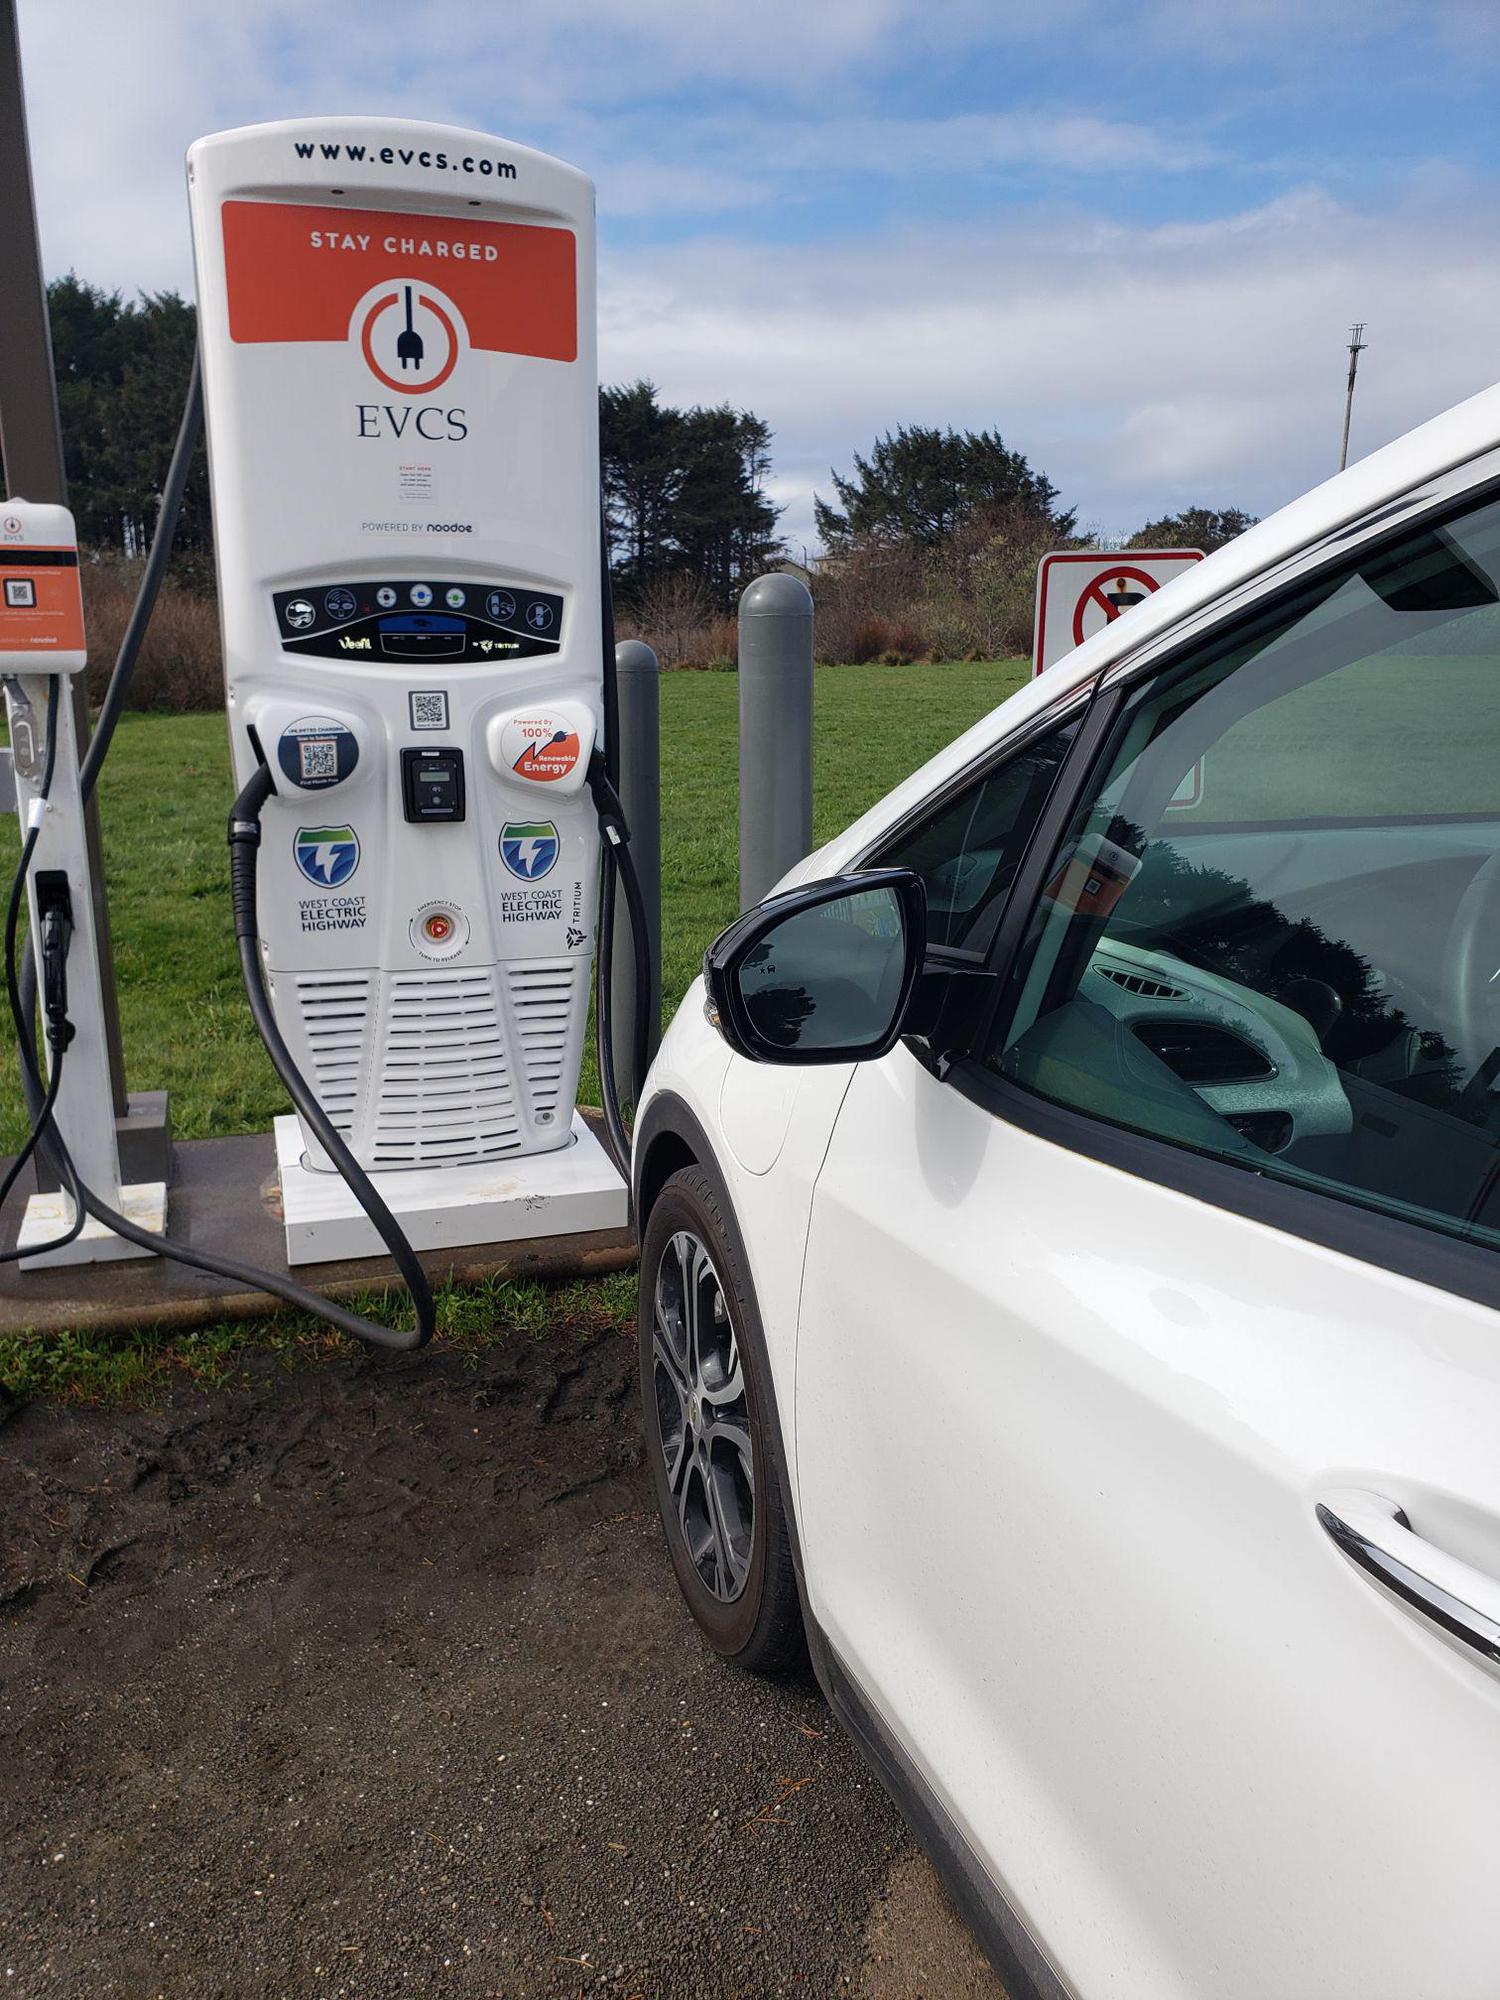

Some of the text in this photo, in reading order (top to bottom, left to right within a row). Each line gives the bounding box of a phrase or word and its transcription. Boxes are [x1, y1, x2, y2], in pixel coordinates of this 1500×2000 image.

[294, 141, 517, 180] www.evcs.com
[310, 231, 499, 262] STAY CHARGED
[355, 404, 468, 442] EVCS
[361, 522, 473, 534] POWERED BY noodoe
[521, 727, 553, 738] 100%
[523, 761, 568, 775] Energy
[501, 889, 563, 901] WEST COAST
[298, 896, 366, 910] WEST COAST
[417, 900, 449, 912] EMERGENCY
[502, 899, 562, 912] ELECTRIC
[572, 881, 582, 924] TRITIUM
[300, 906, 367, 921] ELECTRIC
[502, 910, 562, 923] HIGHWAY
[301, 918, 367, 932] HIGHWAY
